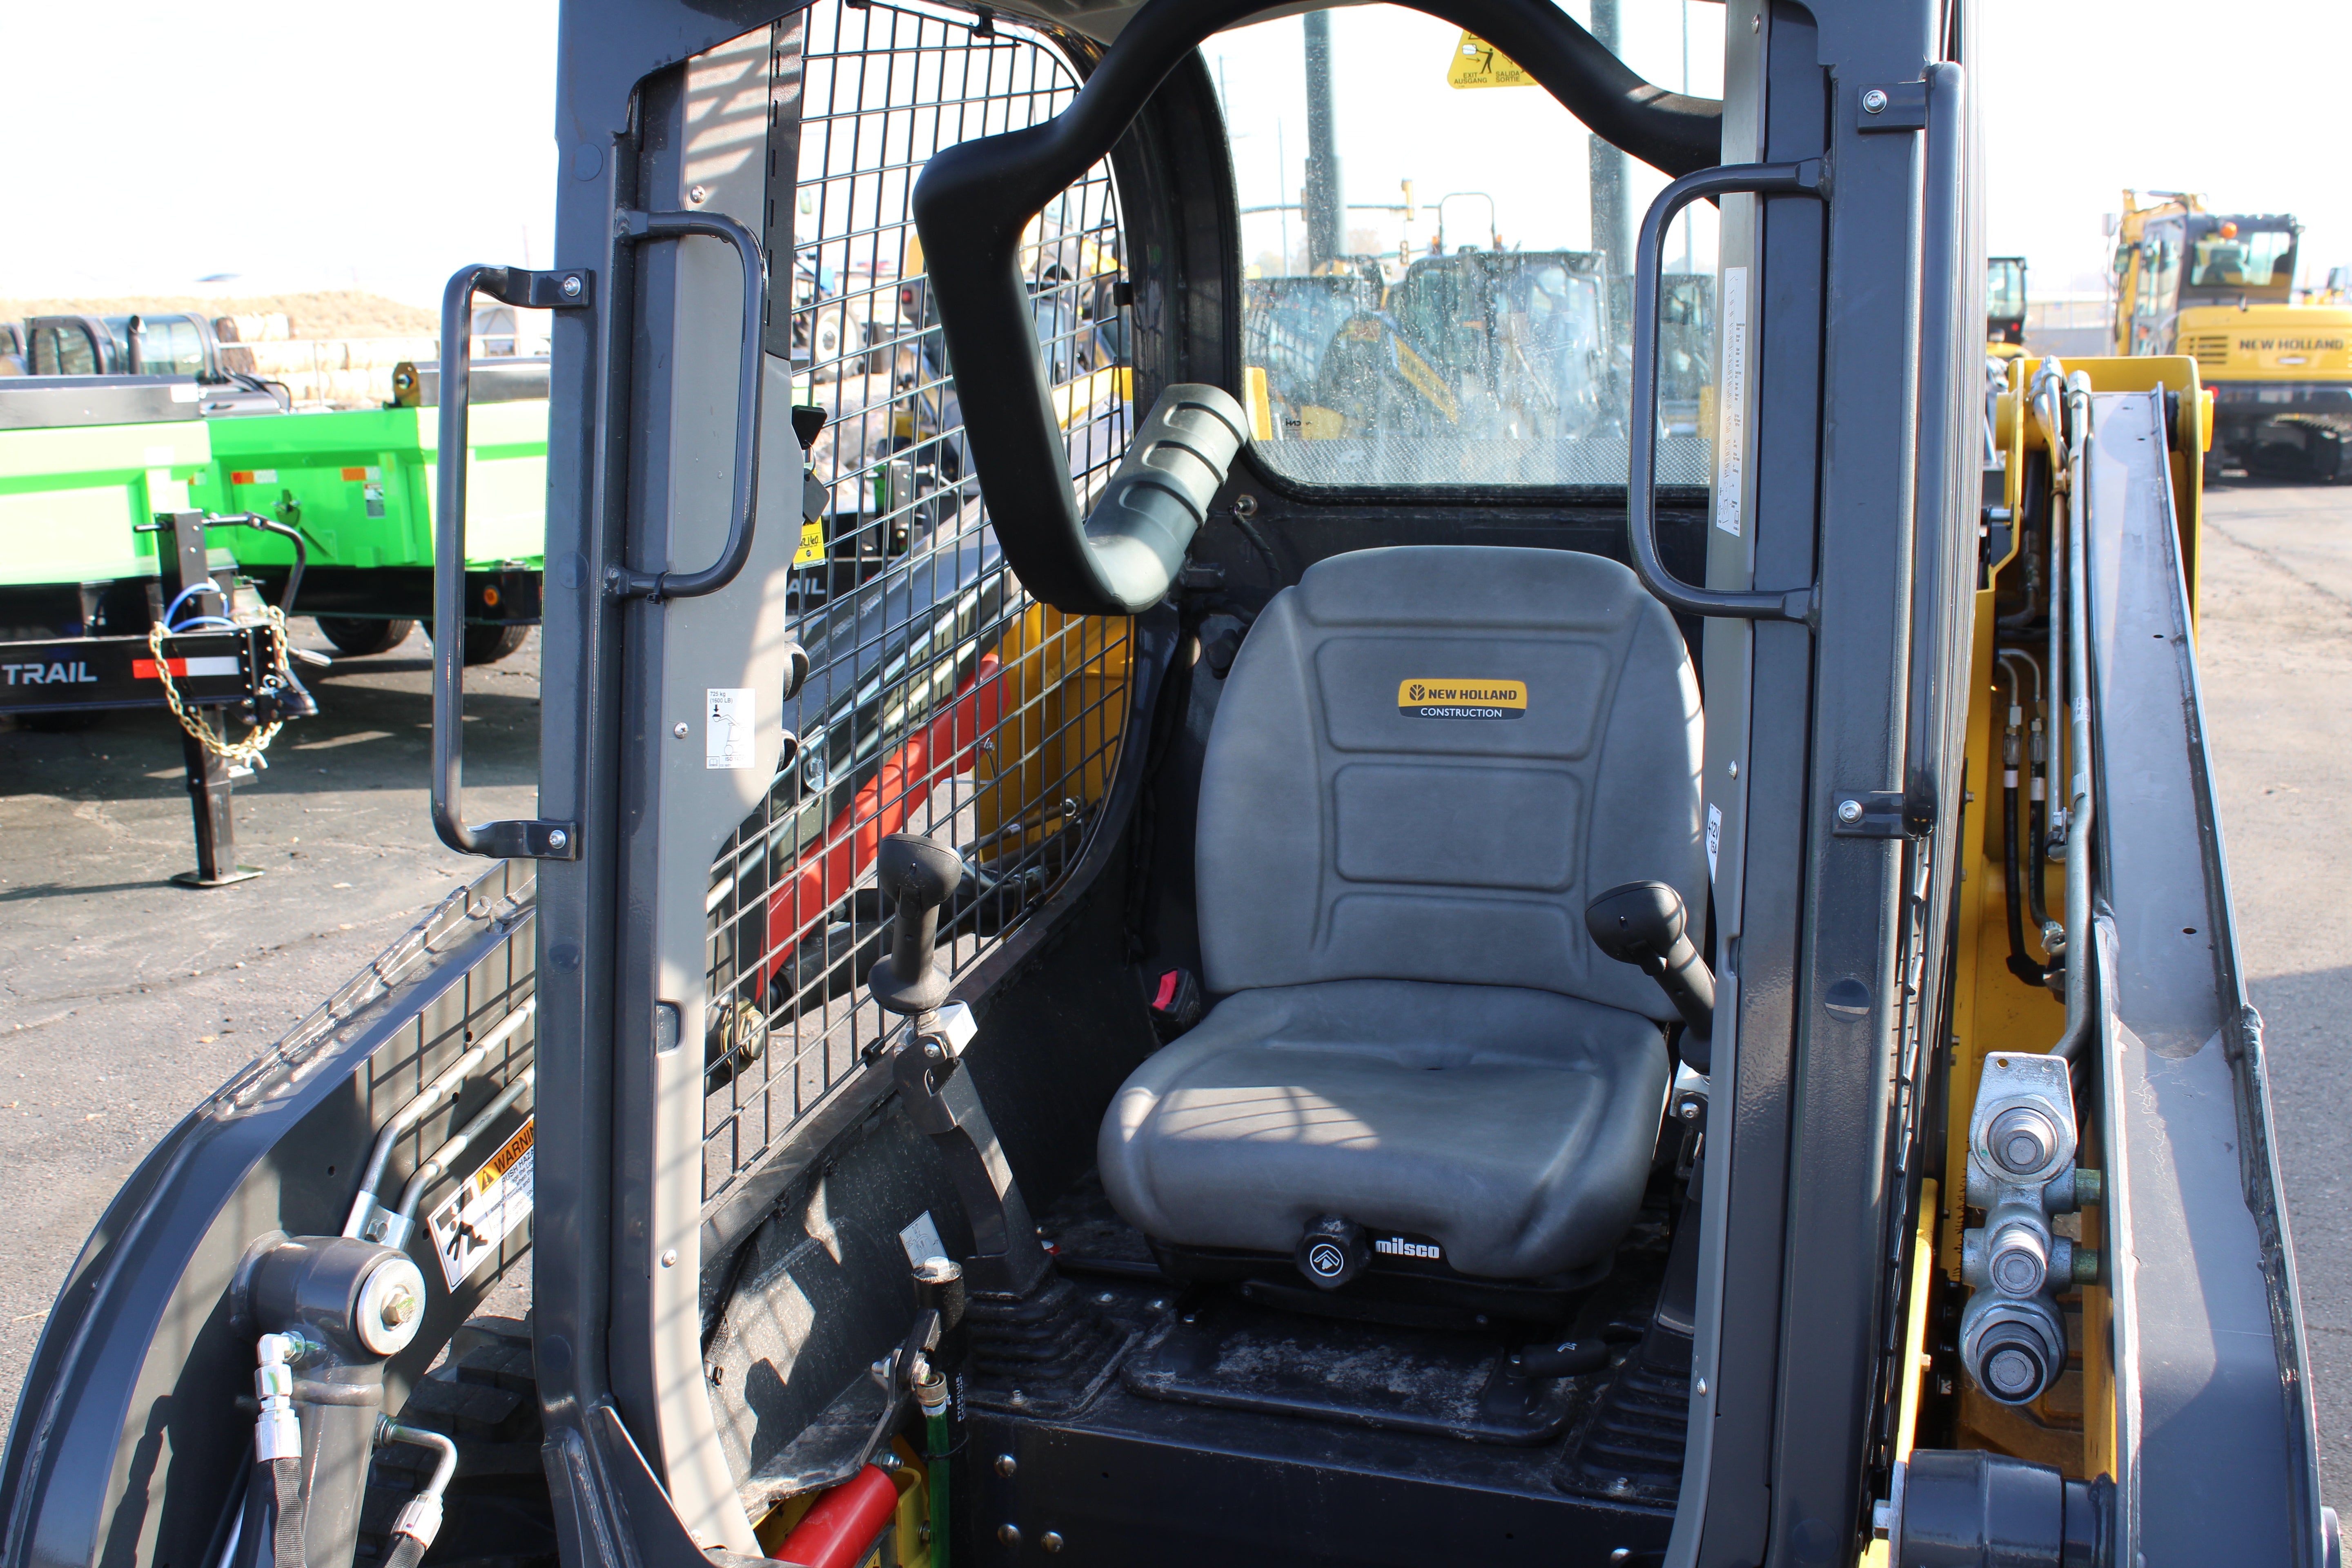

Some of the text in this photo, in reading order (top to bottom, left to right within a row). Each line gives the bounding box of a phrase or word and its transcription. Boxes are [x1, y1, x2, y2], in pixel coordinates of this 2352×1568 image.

[2240, 339, 2344, 350] NEW HOLLAND
[2, 661, 98, 685] TRAIL
[1428, 689, 1517, 701] NEW HOLLAND
[1420, 707, 1502, 718] CONSTRUCTION
[1711, 820, 1720, 840] 12V
[1375, 1237, 1440, 1259] milsco
